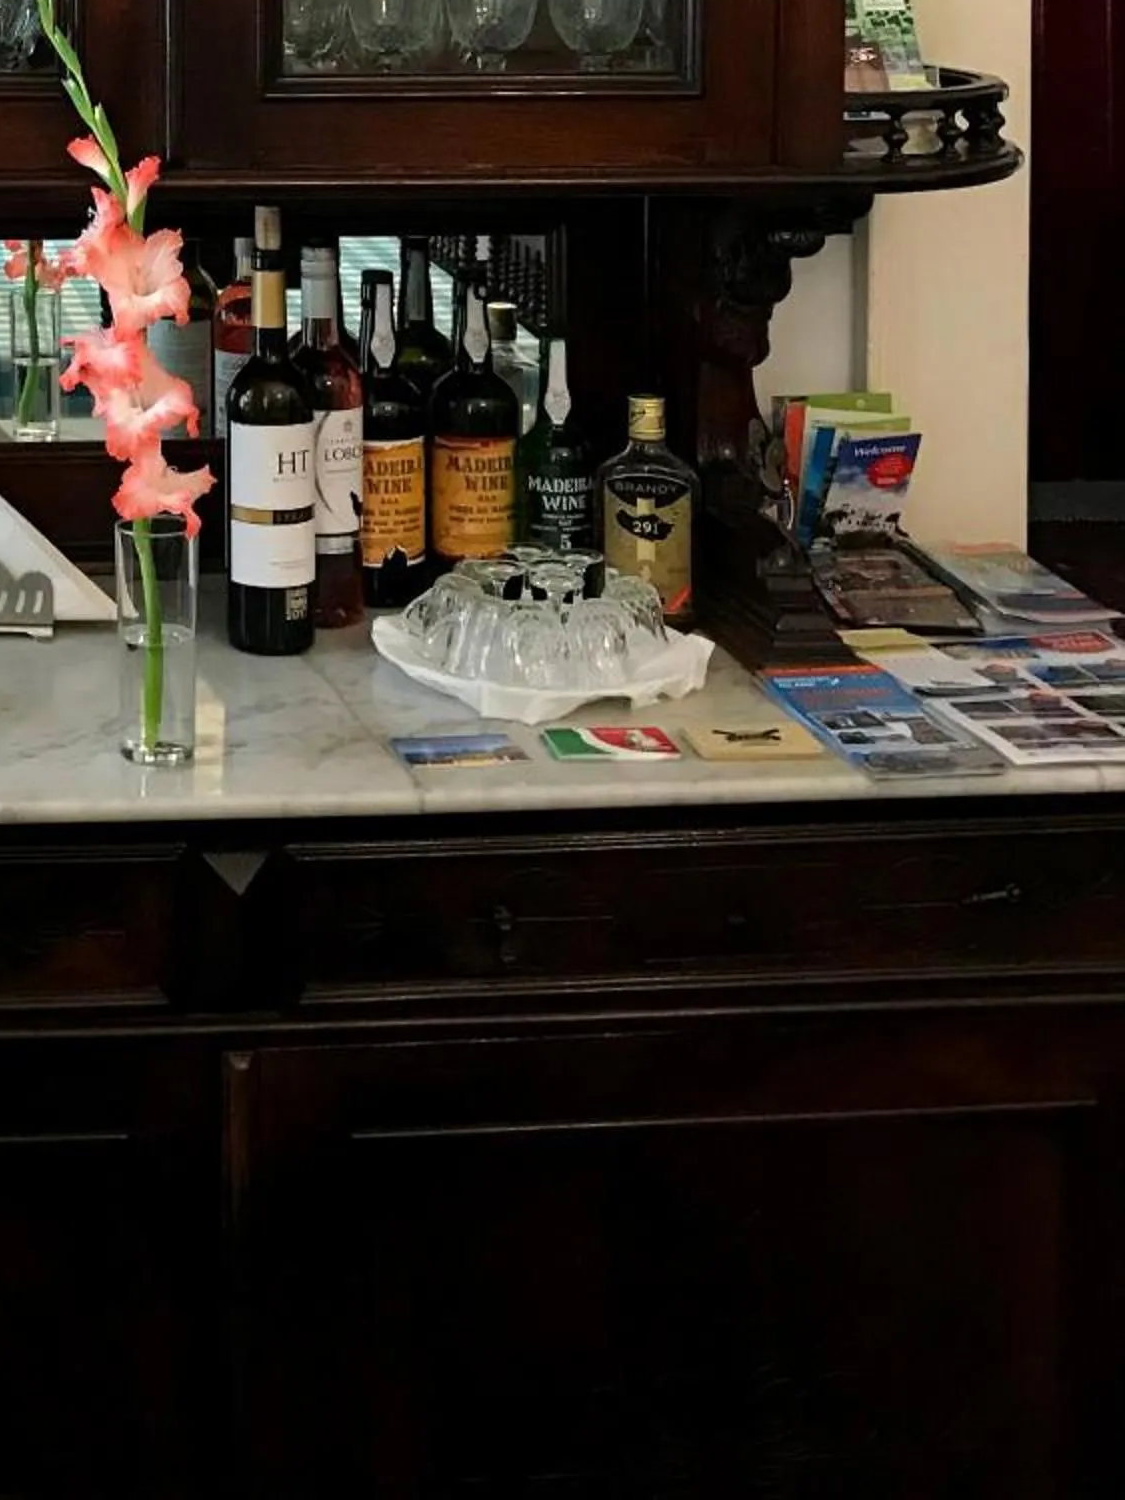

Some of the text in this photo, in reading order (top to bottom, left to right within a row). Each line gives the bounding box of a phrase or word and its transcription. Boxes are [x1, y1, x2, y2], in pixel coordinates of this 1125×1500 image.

[277, 449, 310, 475] HT
[366, 477, 412, 495] WINE
[464, 475, 509, 493] WINE
[613, 480, 679, 496] BRANDY
[541, 494, 587, 512] WINE
[631, 520, 660, 536] 291
